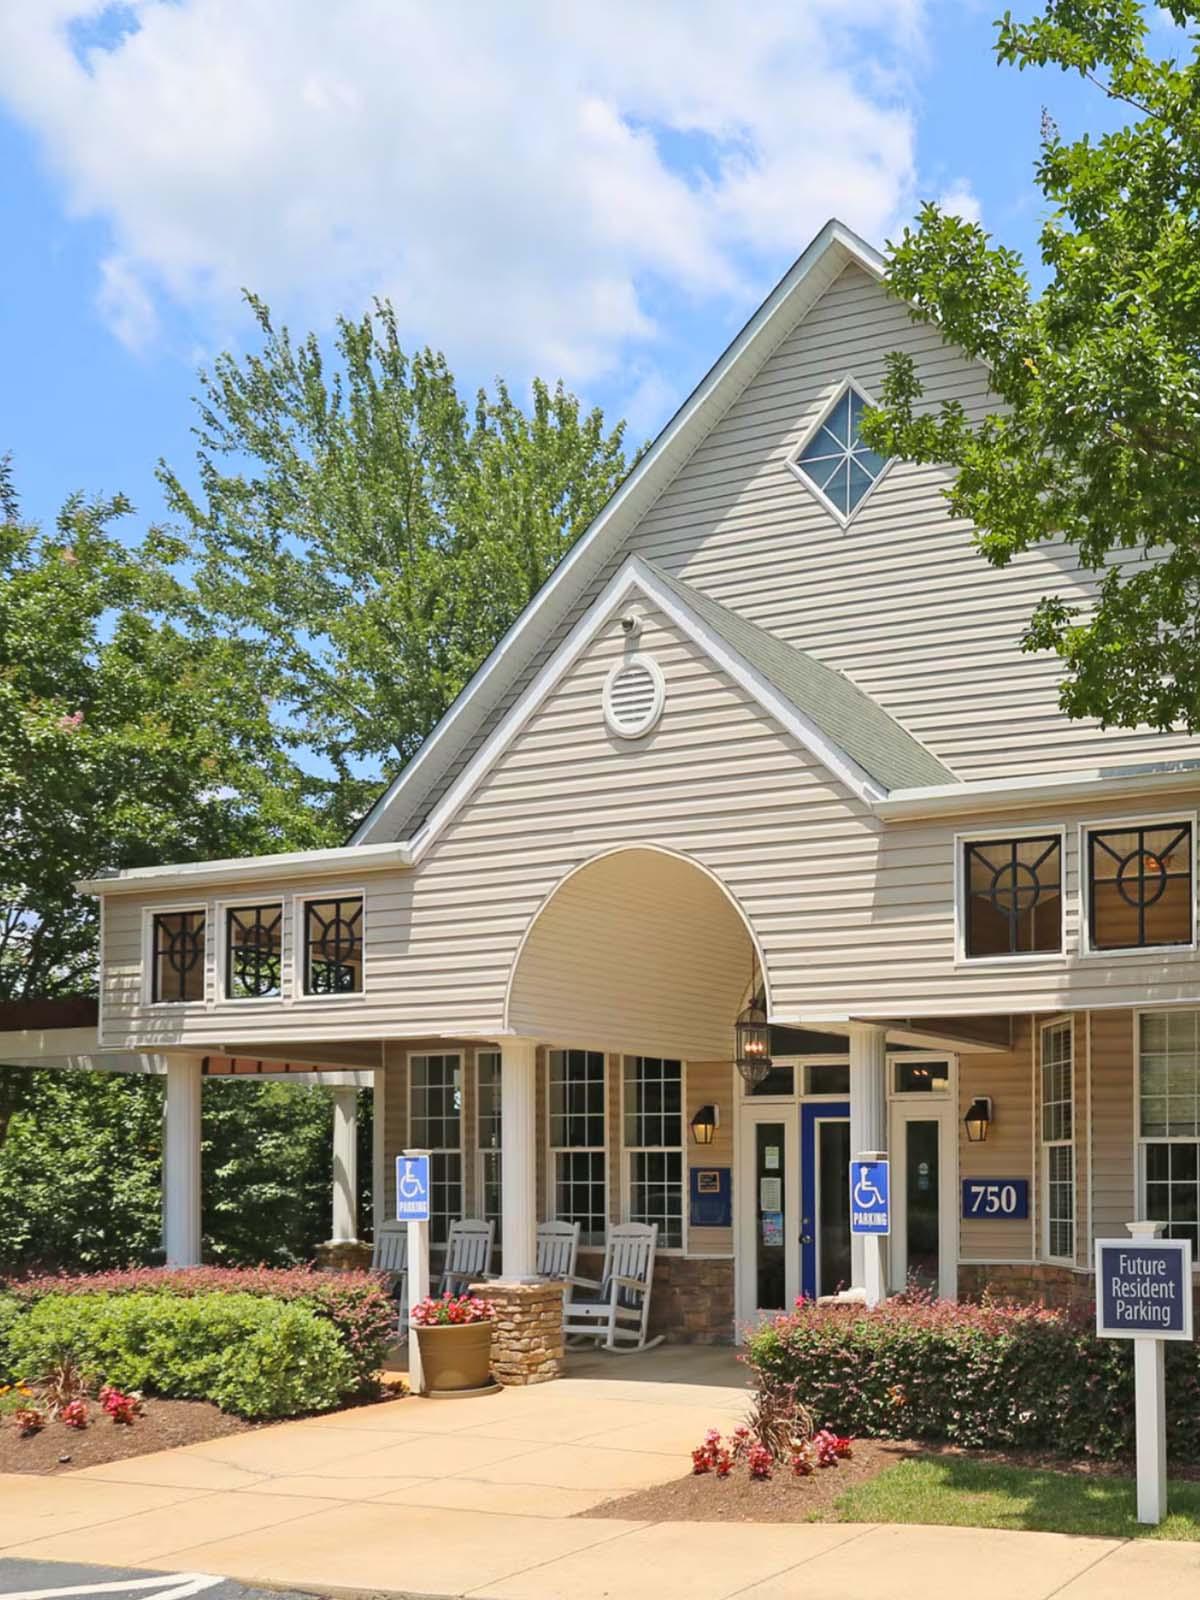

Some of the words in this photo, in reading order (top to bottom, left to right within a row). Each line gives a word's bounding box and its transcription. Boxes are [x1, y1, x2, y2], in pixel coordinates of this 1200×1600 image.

[971, 1185, 1017, 1213] 750
[853, 1213, 887, 1226] PARKING
[1120, 1254, 1167, 1276] Future
[1111, 1277, 1175, 1299] Resident
[1116, 1300, 1171, 1327] Parking
